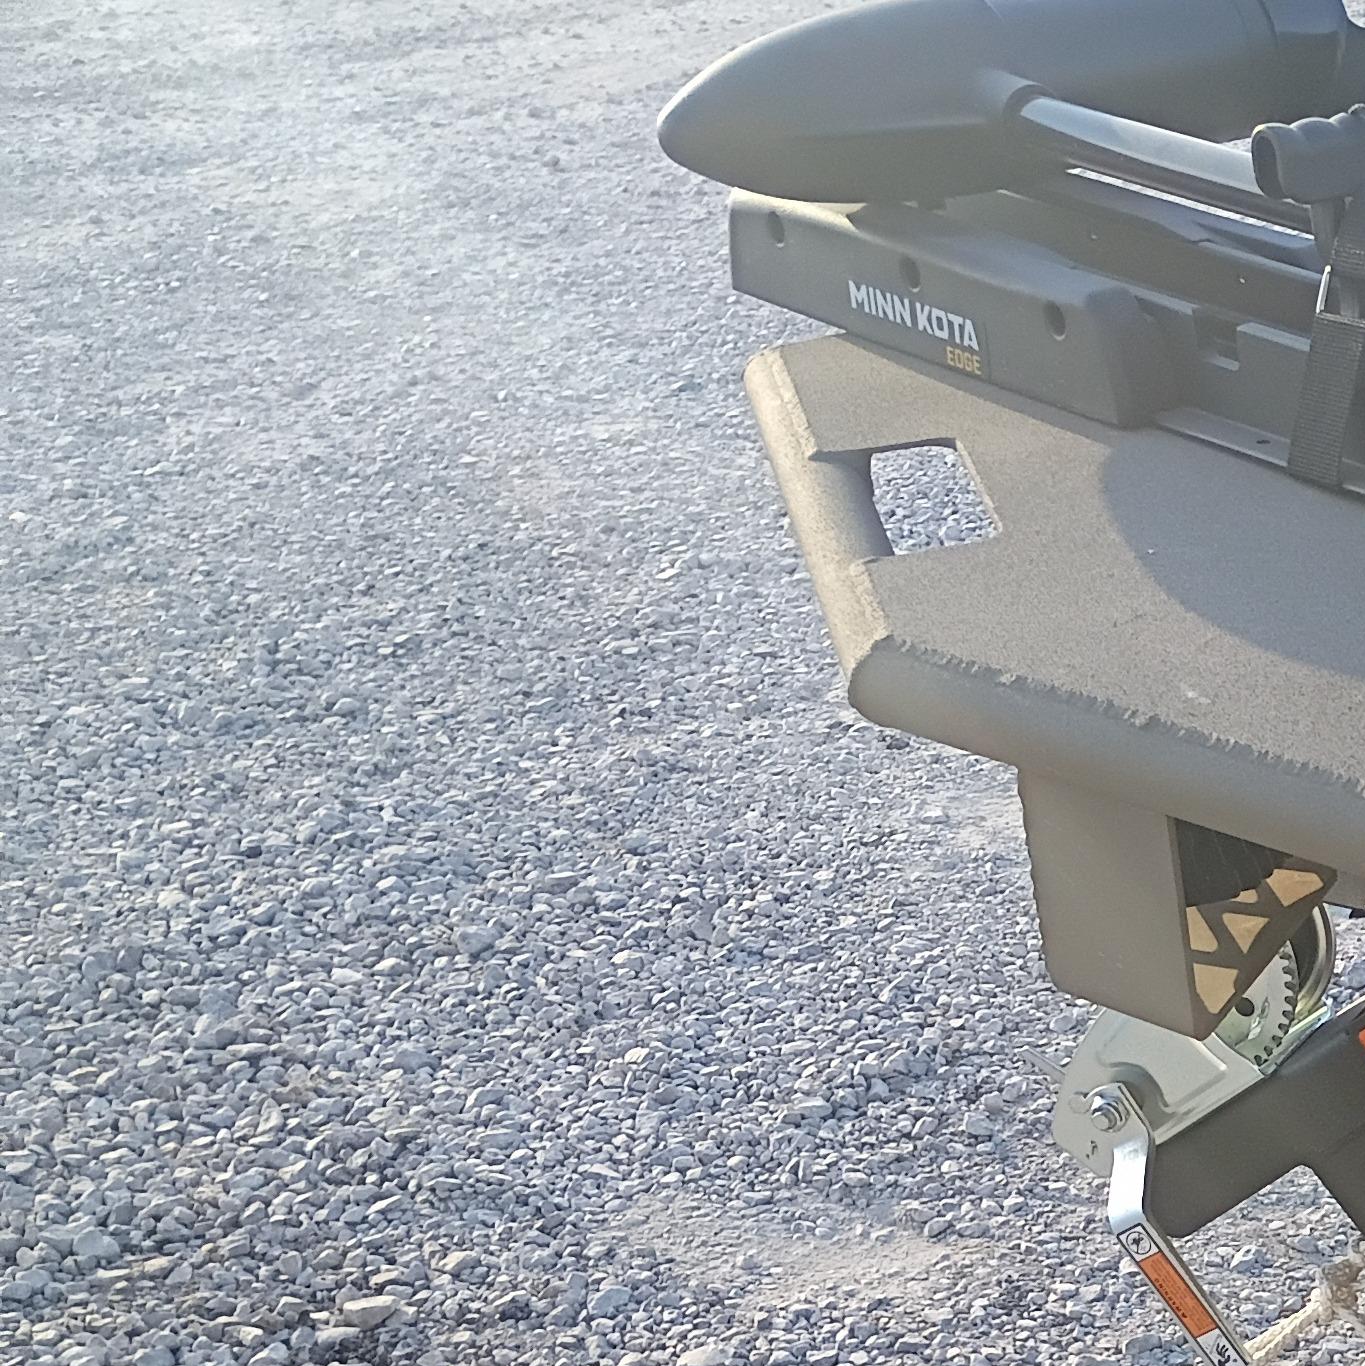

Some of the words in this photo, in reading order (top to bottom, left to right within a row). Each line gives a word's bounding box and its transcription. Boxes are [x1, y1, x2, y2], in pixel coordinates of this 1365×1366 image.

[848, 279, 912, 328] MINN
[915, 302, 980, 351] KOTA
[946, 346, 982, 375] EDGE
